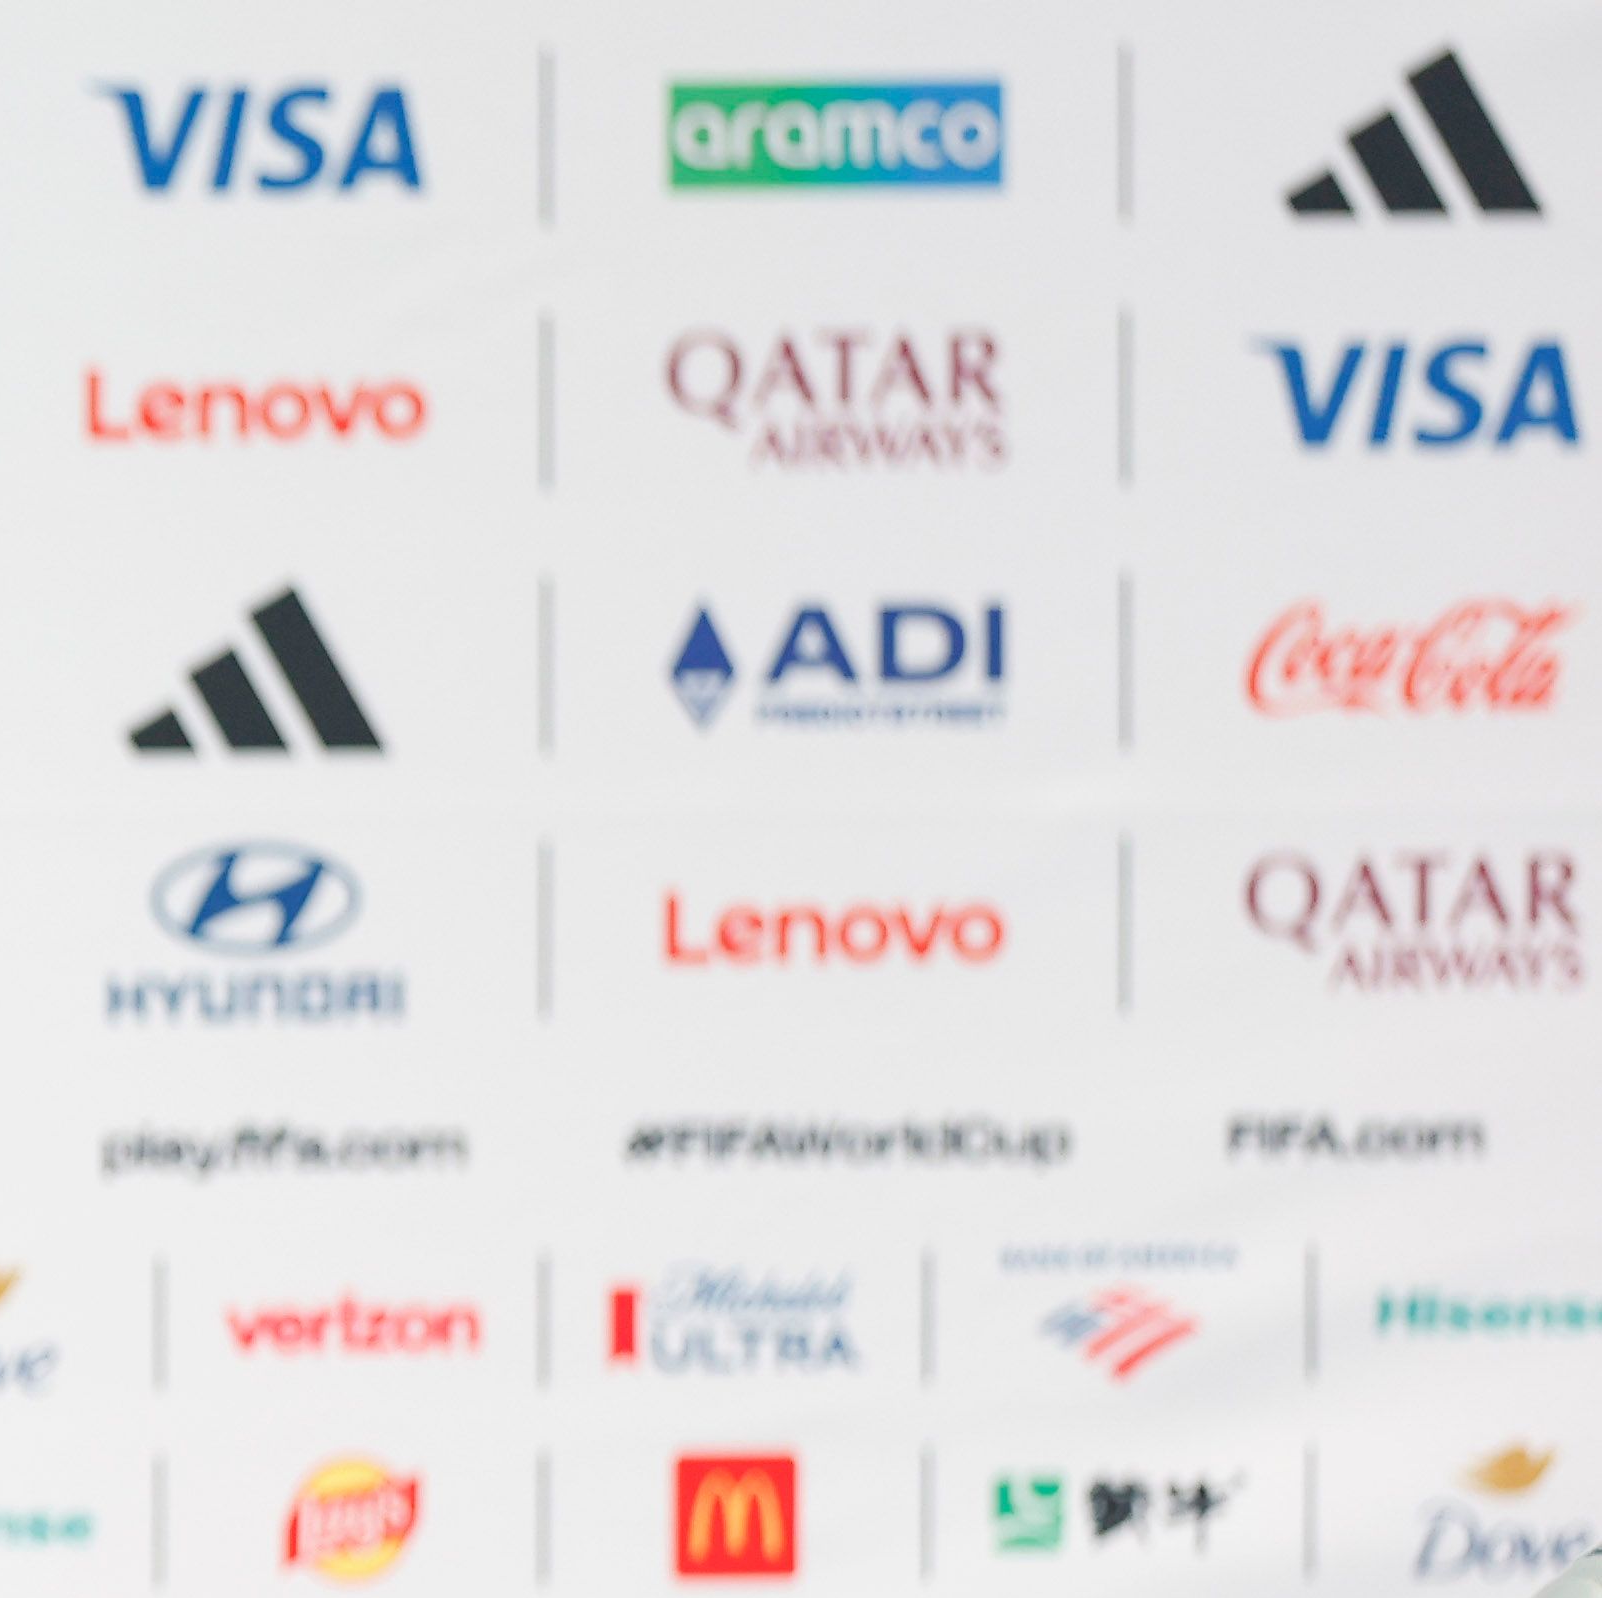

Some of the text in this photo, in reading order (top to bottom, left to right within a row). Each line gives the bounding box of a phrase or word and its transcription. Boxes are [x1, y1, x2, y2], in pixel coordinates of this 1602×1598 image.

[113, 85, 422, 193] VISA
[674, 102, 1001, 169] aramco
[85, 370, 428, 442] Lenovo
[665, 332, 999, 430] QATAR
[1272, 340, 1580, 448] VISA
[756, 426, 1006, 466] AIRWAYS
[766, 603, 1005, 685] ADI
[663, 893, 1005, 965] Lenovo
[1244, 854, 1577, 952] QATAR
[107, 973, 405, 1023] HYUNDAI
[1333, 938, 1584, 989] AIRWAYS
[227, 1296, 482, 1353] verizon
